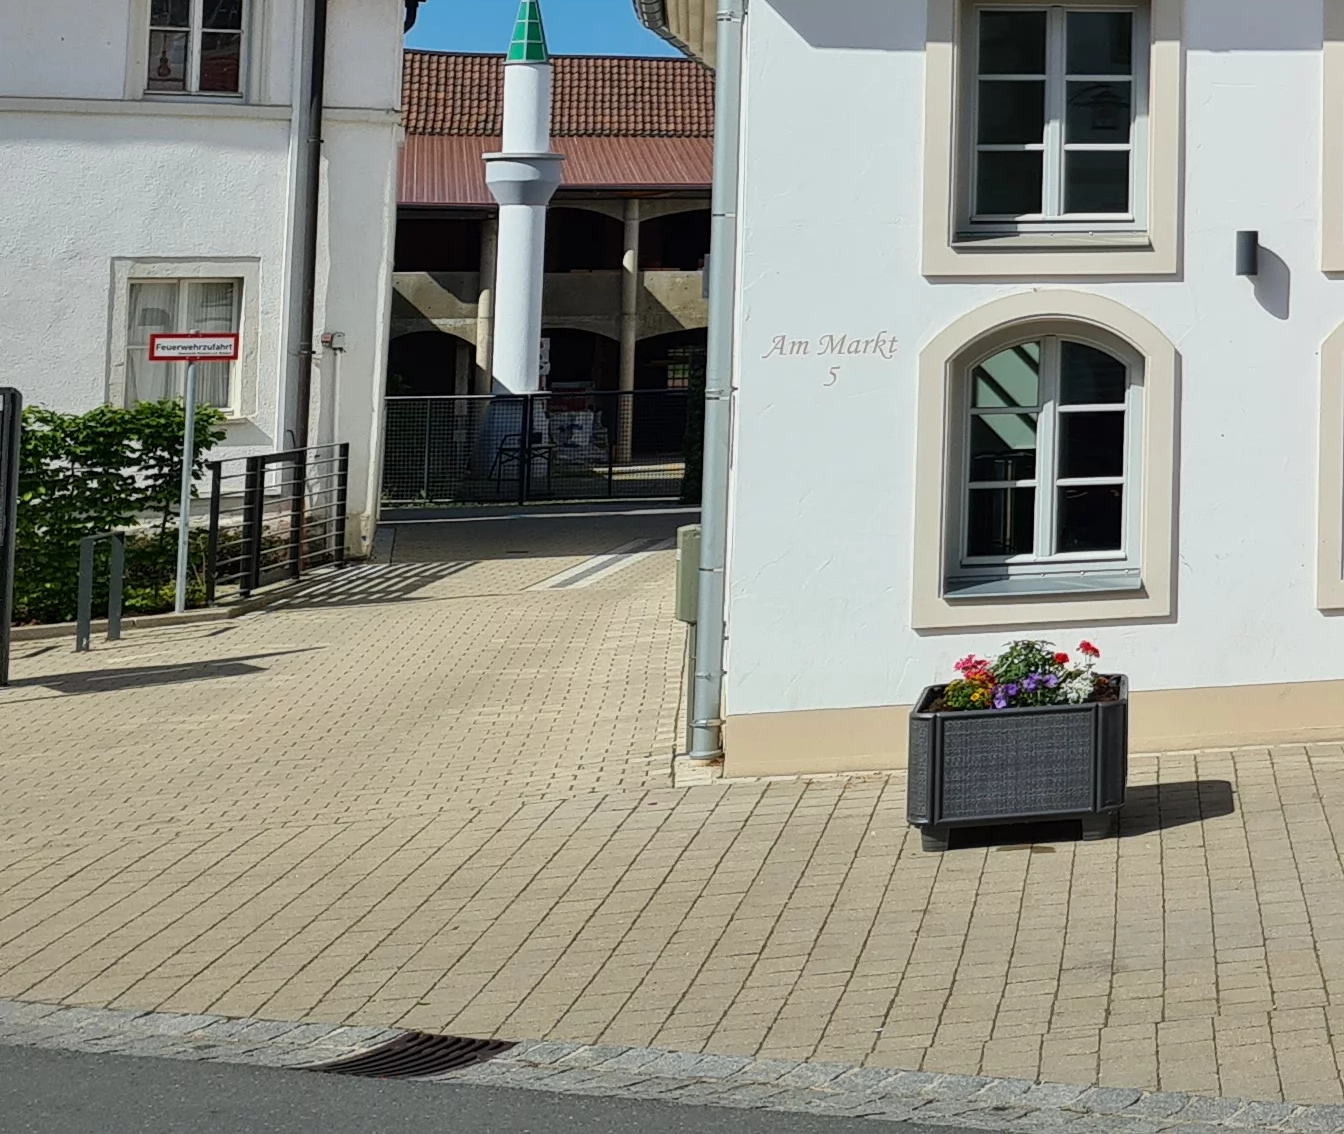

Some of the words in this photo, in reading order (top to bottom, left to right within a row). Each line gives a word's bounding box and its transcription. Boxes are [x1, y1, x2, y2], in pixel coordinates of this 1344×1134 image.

[156, 343, 232, 352] Feuerwehrzufahrt
[761, 334, 809, 359] Am
[817, 330, 898, 359] Markt
[823, 366, 841, 386] 5
